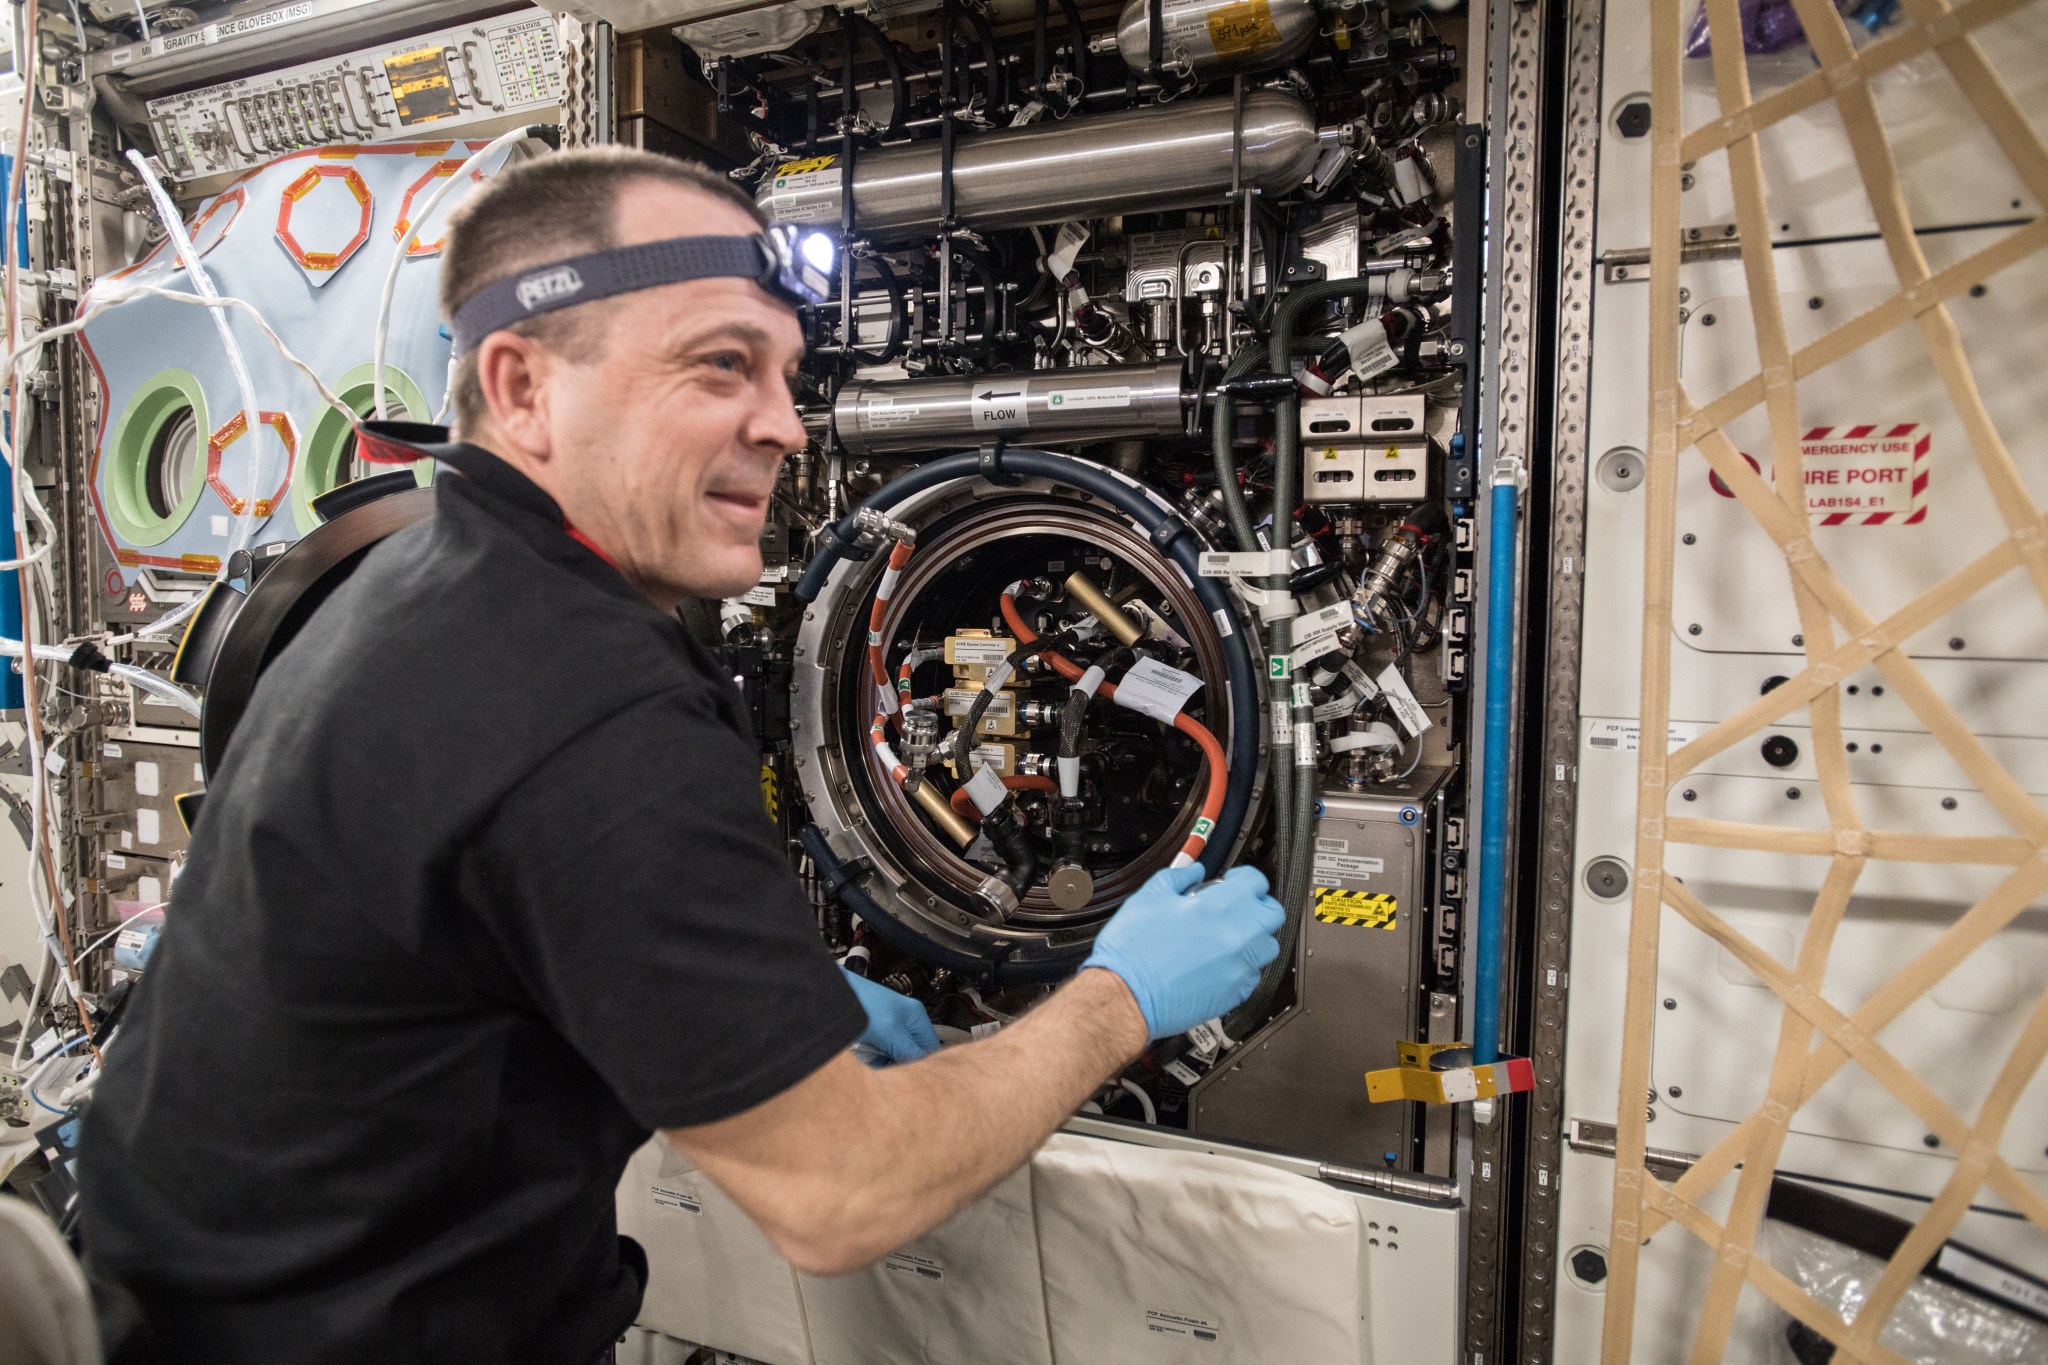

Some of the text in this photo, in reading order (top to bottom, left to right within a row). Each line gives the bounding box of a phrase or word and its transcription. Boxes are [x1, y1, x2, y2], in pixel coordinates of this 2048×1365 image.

[142, 3, 311, 56] MIOGRAVITY SENCE GLOVEBOX (MSG)
[526, 22, 541, 30] STATUS
[1216, 22, 1260, 40] 391 psia
[151, 96, 174, 108] COMMAND
[175, 93, 185, 103] AND
[186, 86, 217, 100] MONITORING
[217, 83, 234, 93] PANEL
[520, 271, 585, 311] PETZL
[1572, 344, 1579, 357] D1
[1511, 351, 1518, 364] D2
[983, 409, 1016, 421] FLOW
[1802, 443, 1910, 455] MERGENCY USE
[1804, 468, 1908, 484] IRE PORT
[1810, 497, 1884, 508] LAB1S4_E1
[1565, 559, 1571, 571] E1
[1338, 857, 1379, 866] Instrumentation
[1484, 1165, 1490, 1176] H2
[1540, 1172, 1546, 1184] H1
